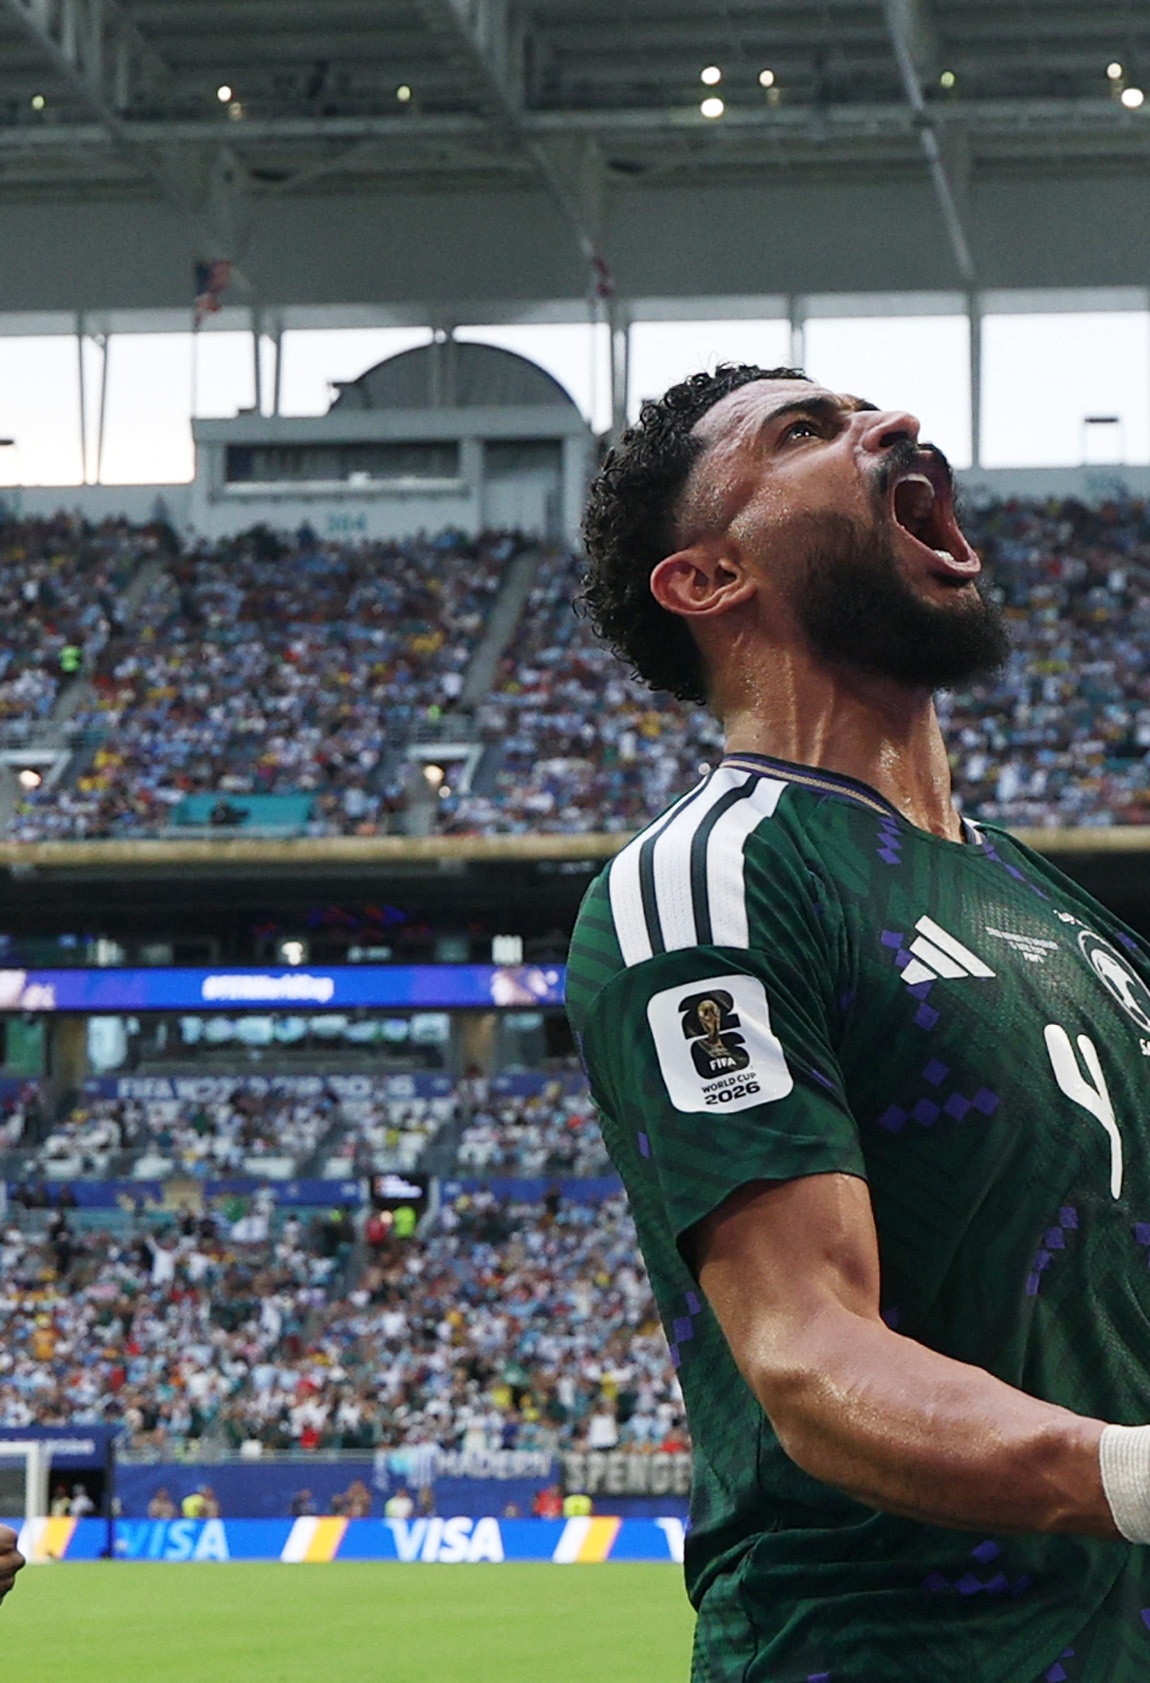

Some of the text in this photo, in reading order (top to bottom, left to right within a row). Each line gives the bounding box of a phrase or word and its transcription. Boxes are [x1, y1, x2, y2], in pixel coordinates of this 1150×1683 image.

[709, 1057, 736, 1070] FIFA
[701, 1072, 757, 1094] WORLD CUP
[704, 1081, 761, 1105] 2026
[1043, 1023, 1124, 1200] 4
[118, 1519, 229, 1561] VISA
[384, 1517, 504, 1562] VISA
